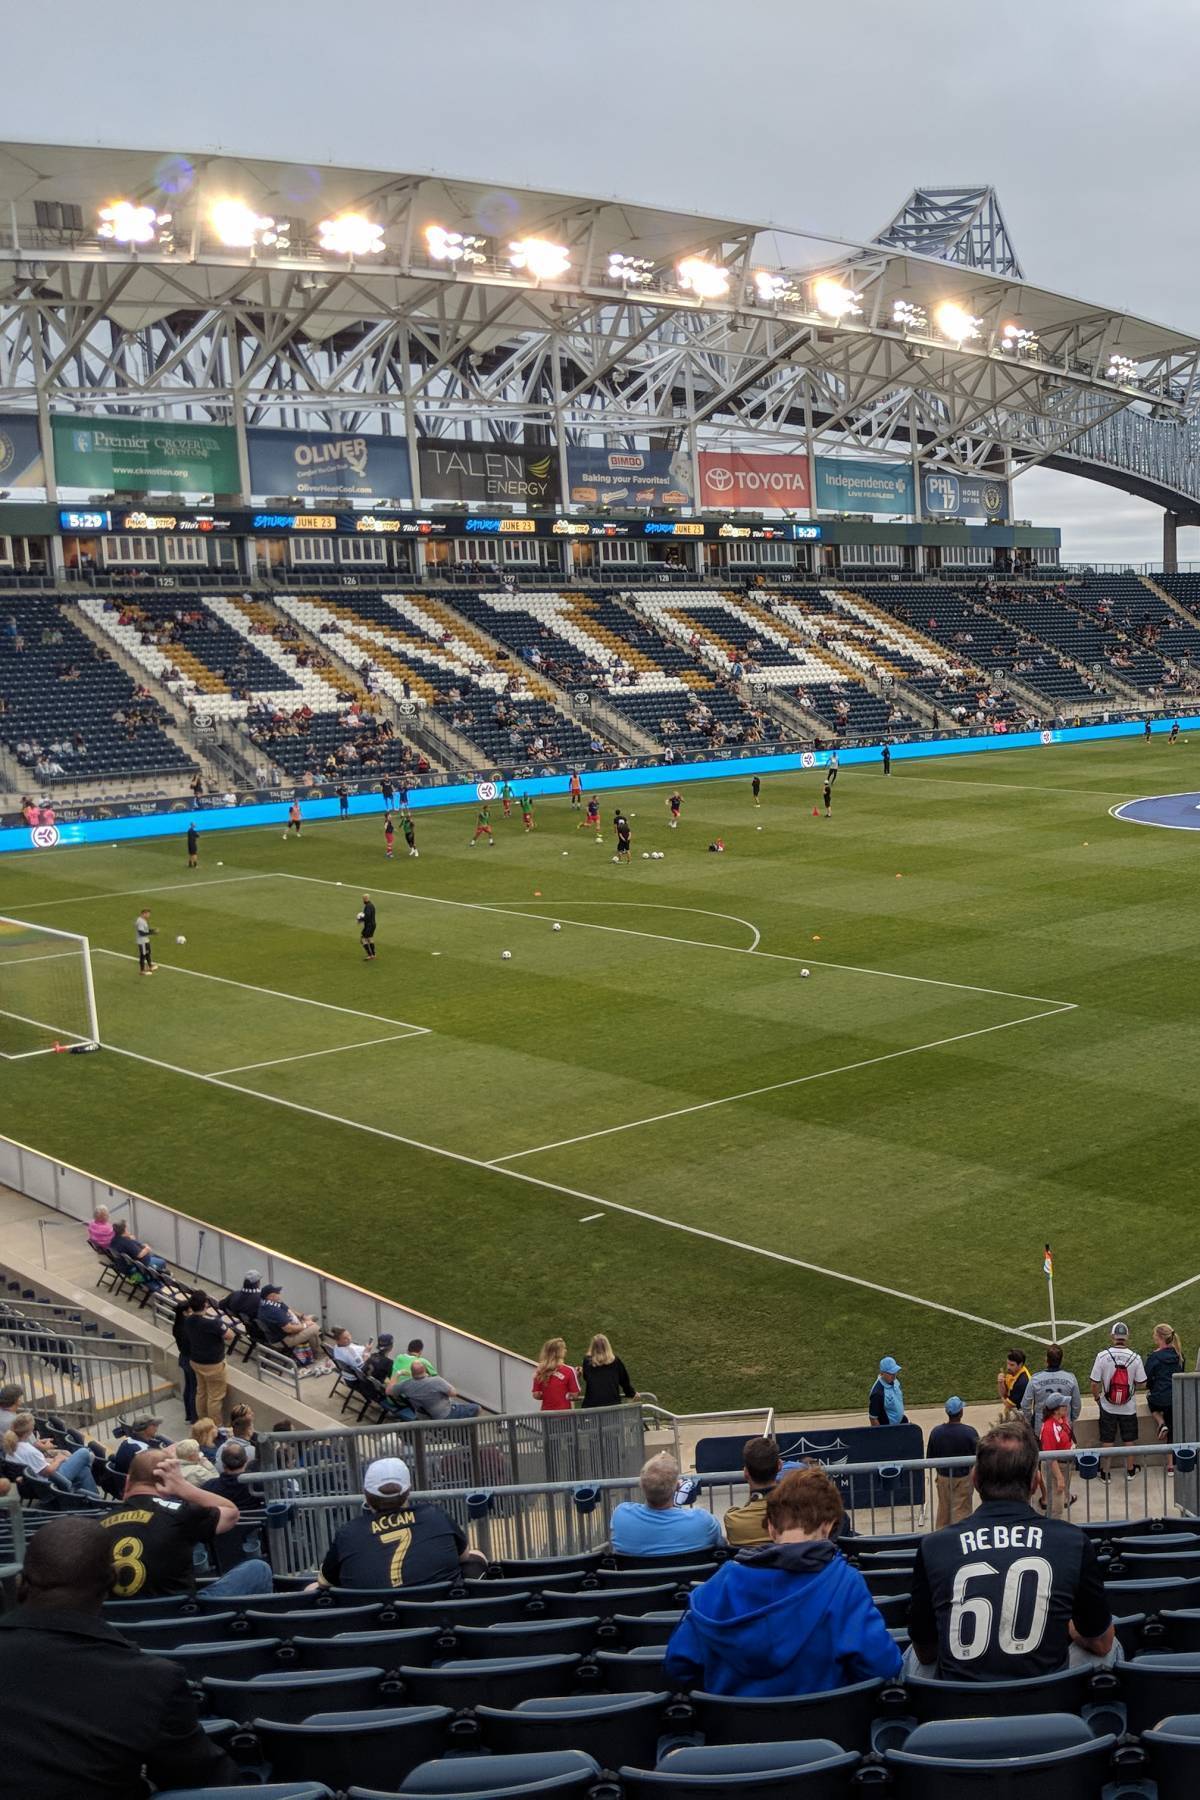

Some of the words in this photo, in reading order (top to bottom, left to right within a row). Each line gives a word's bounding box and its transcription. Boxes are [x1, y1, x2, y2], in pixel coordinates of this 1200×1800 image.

[94, 431, 150, 449] Premier
[295, 438, 367, 465] OLIVER
[428, 449, 523, 478] TALEN
[610, 456, 642, 466] BIMBO
[582, 473, 612, 484] Baking
[613, 476, 631, 484] your
[632, 476, 670, 485] Favorites!
[735, 472, 805, 490] TOYOTA
[826, 473, 894, 490] Independence
[929, 478, 955, 494] PHL
[487, 480, 548, 496] ENERGY
[962, 489, 980, 497] HOME
[943, 494, 956, 509] 17
[69, 514, 102, 528] 5:29
[296, 516, 318, 527] JUNE
[321, 516, 332, 527] 23
[501, 521, 520, 531] JUNE
[523, 521, 532, 531] 23
[676, 525, 691, 534] JUNE
[693, 525, 702, 534] 23
[798, 527, 817, 537] 5:29
[159, 577, 175, 587] 125
[343, 576, 357, 585] 126
[503, 575, 516, 583] 127
[659, 574, 670, 582] 128
[781, 574, 791, 582] 129
[371, 1511, 416, 1534] ACCAM
[959, 1525, 1043, 1555] REBER
[380, 1527, 412, 1588] 7
[949, 1556, 1054, 1661] 60
